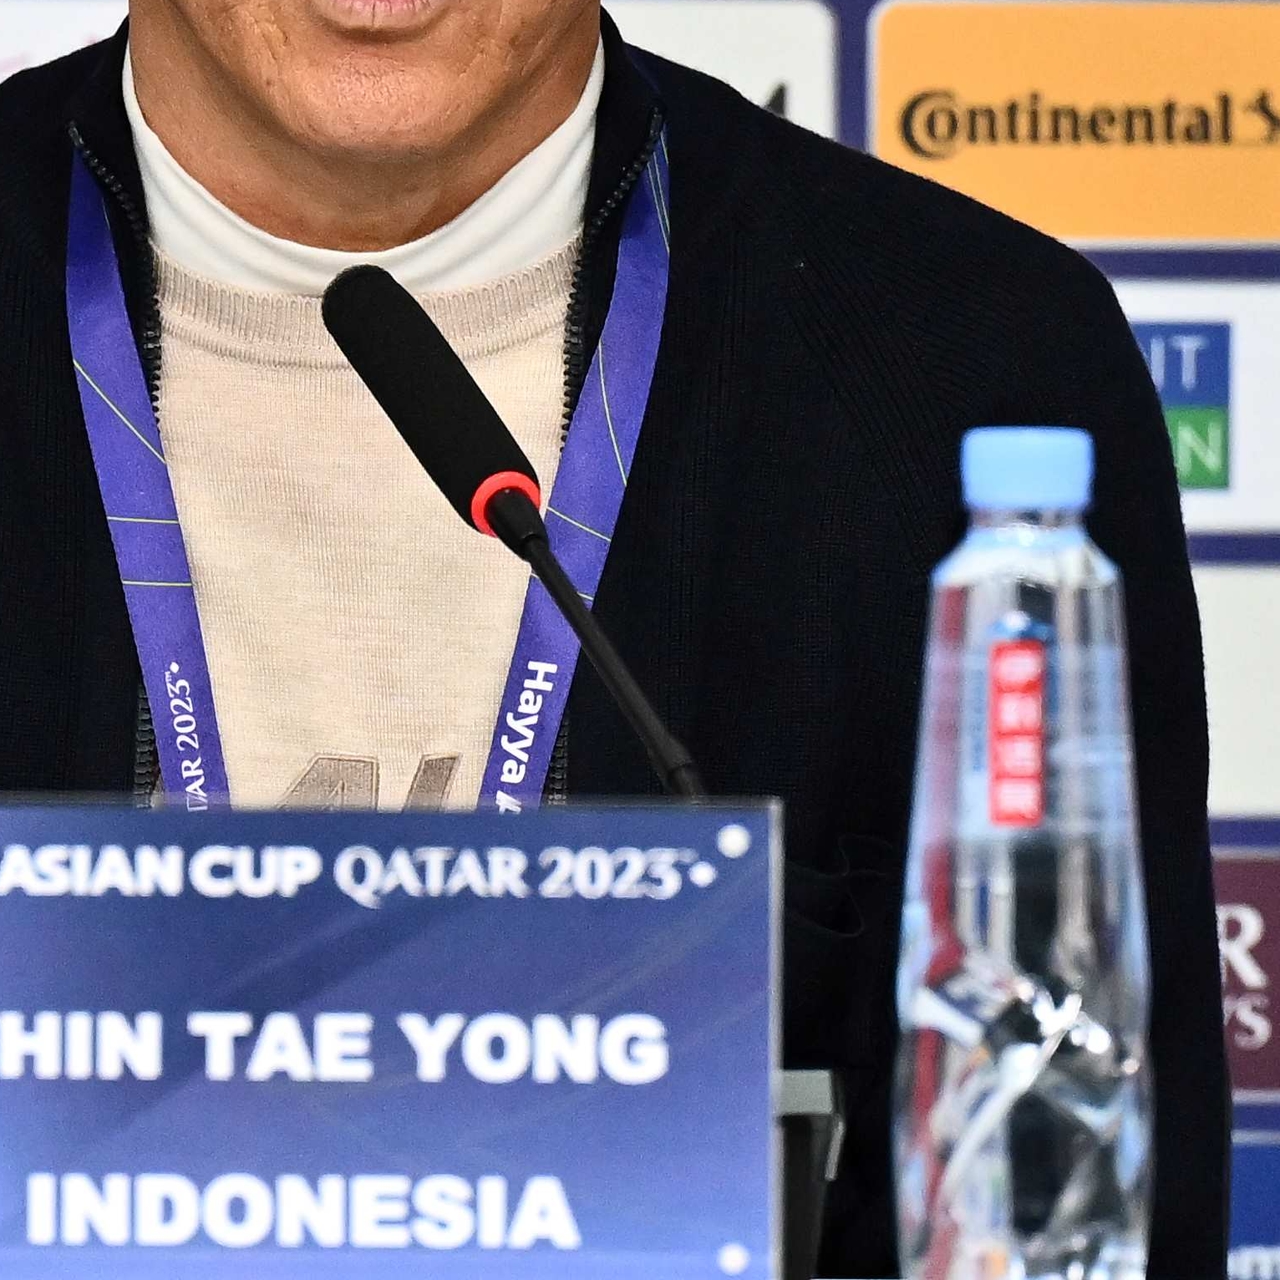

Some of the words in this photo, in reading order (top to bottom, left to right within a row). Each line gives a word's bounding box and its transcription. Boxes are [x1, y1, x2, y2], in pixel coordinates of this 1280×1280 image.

[899, 91, 1232, 159] Continental
[500, 661, 558, 784] Hayya
[189, 845, 322, 897] CUP
[334, 846, 528, 907] QATAR
[188, 1012, 373, 1082] TAE
[399, 1013, 668, 1084] YONG
[28, 1174, 580, 1249] INDONESIA
